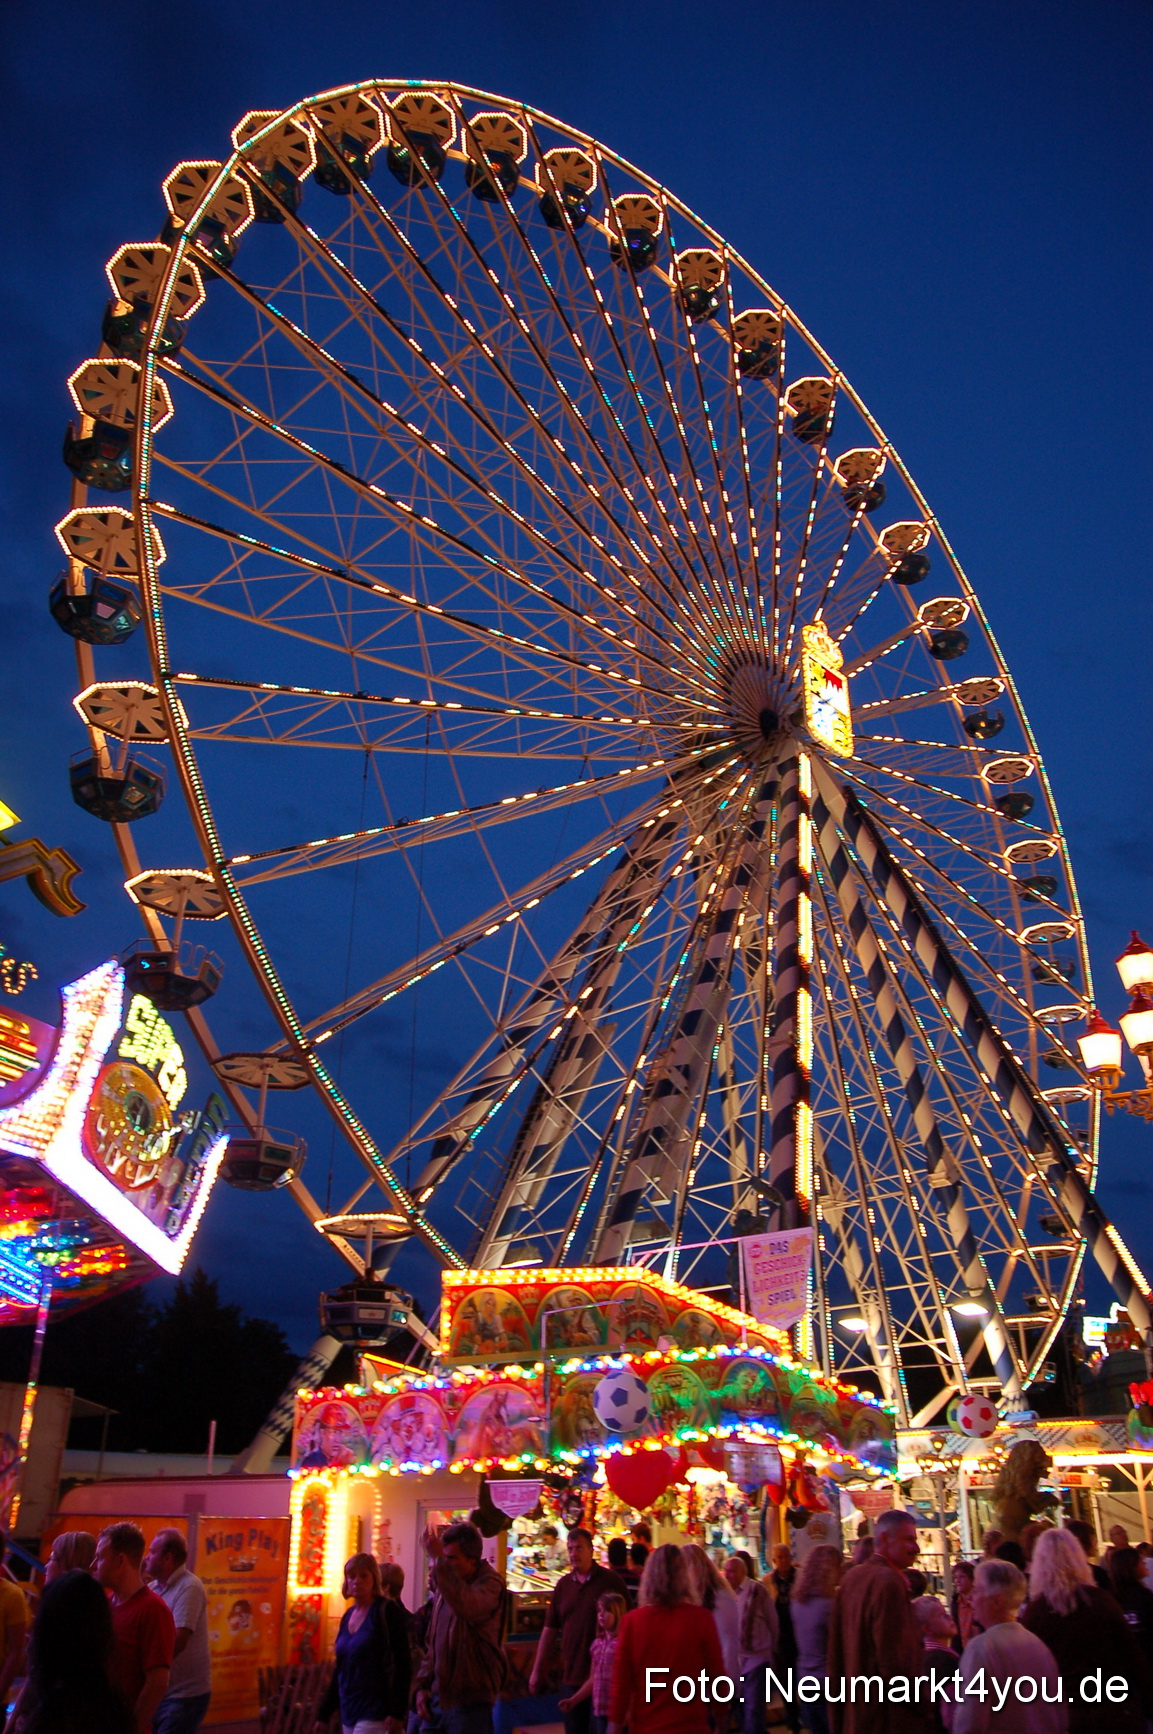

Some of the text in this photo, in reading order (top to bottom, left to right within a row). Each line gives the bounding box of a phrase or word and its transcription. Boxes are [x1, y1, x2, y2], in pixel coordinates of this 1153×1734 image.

[768, 1240, 788, 1255] DAS
[768, 1288, 796, 1306] SPIEL
[206, 1528, 279, 1558] King Play
